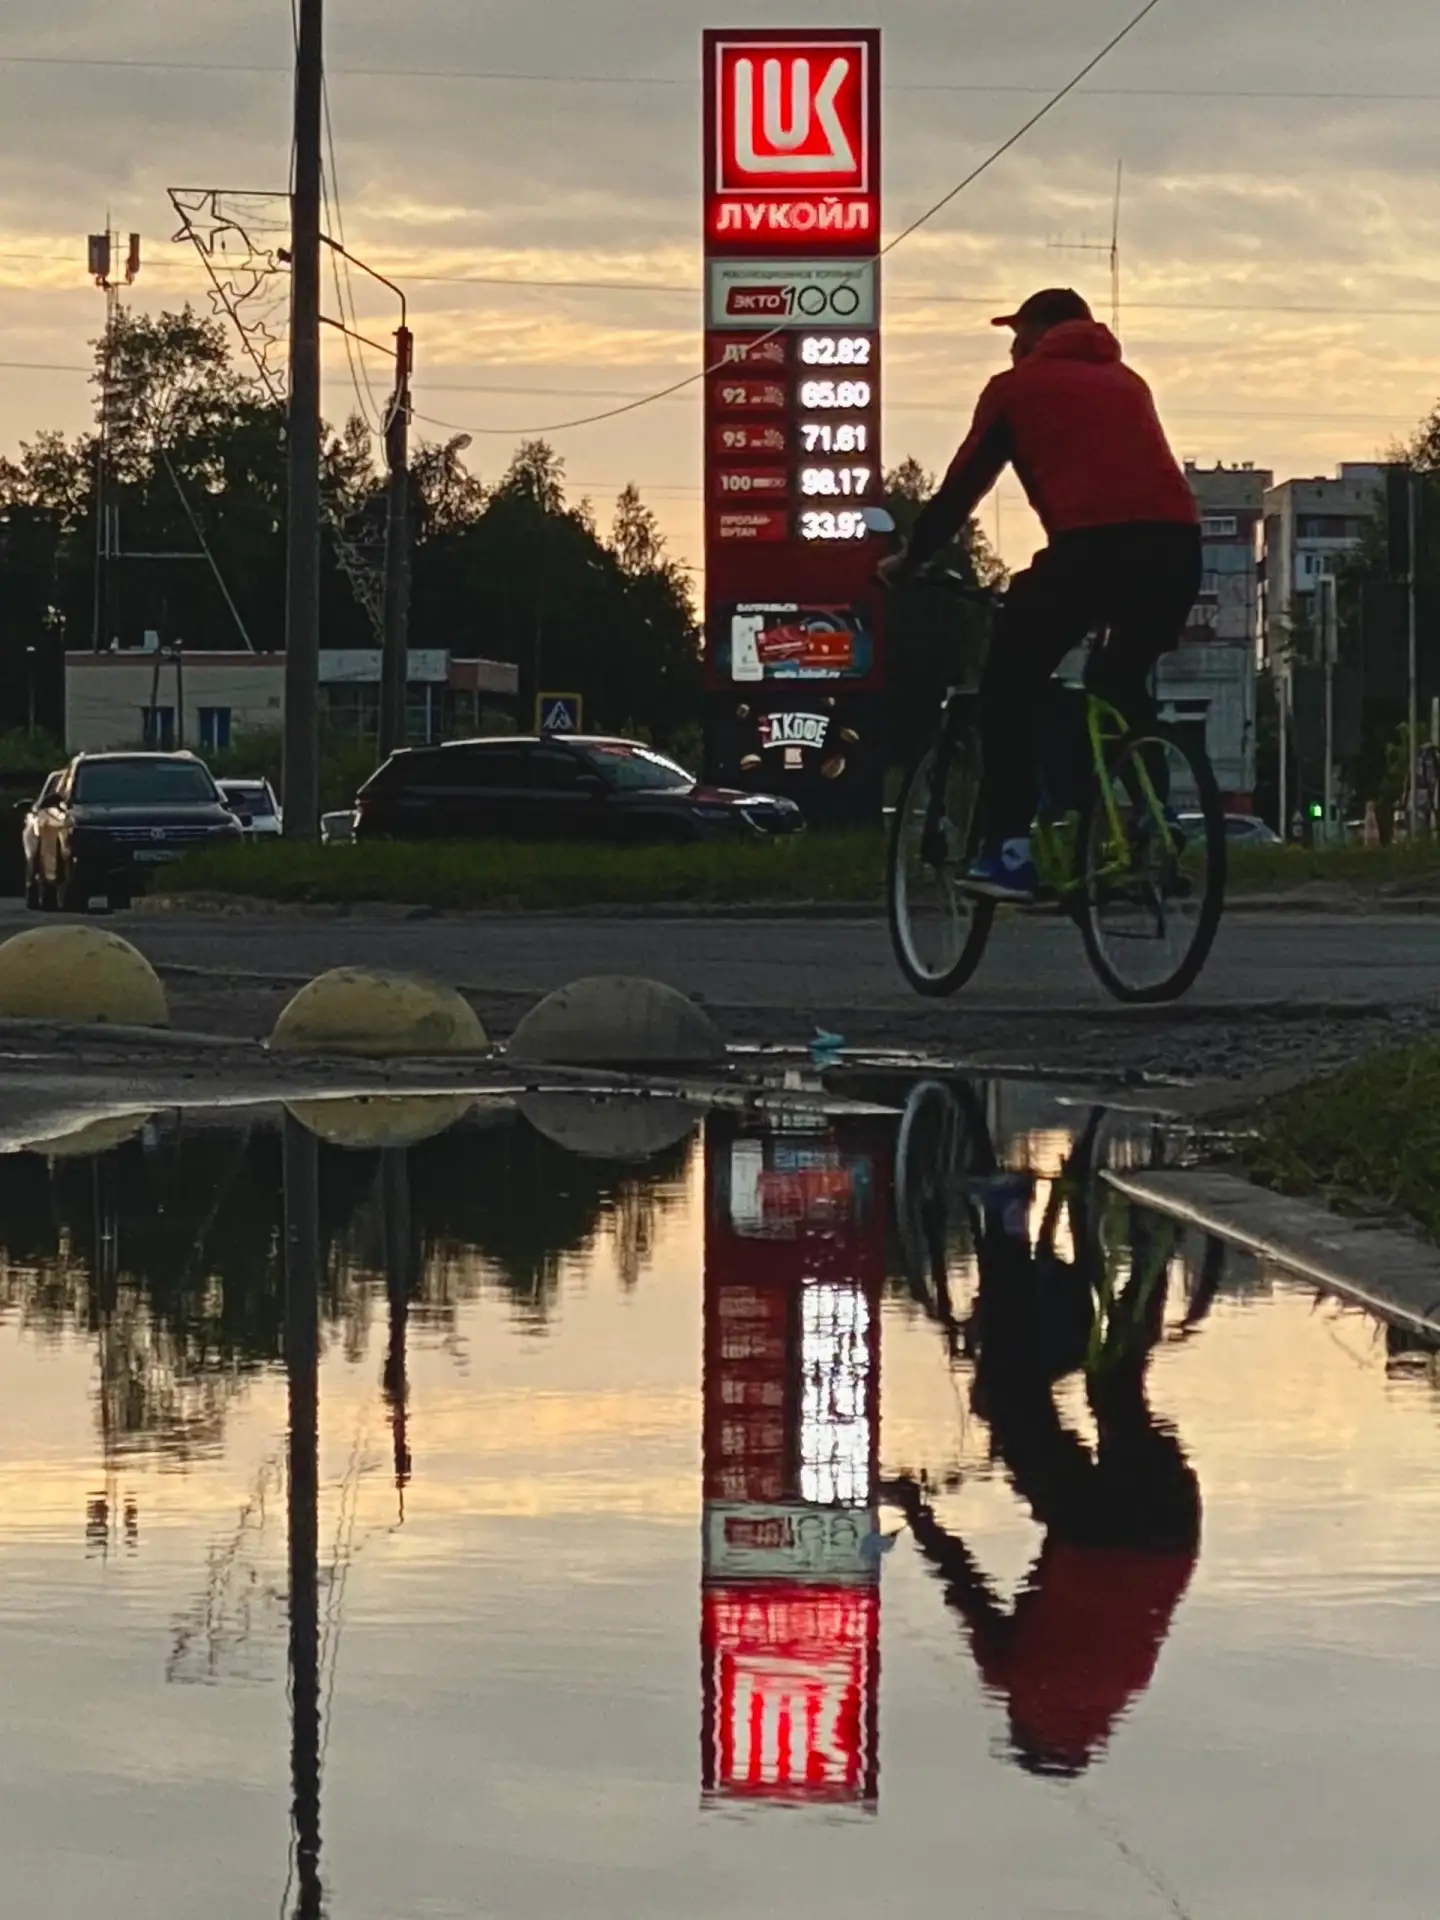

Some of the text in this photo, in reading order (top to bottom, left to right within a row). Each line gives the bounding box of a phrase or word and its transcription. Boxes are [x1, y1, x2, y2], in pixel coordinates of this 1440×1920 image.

[716, 196, 869, 230] ЛУКОЙЛ
[733, 284, 860, 316] ЭКТО 100
[723, 344, 748, 362] ДТ
[722, 387, 747, 404] 92
[722, 431, 747, 448] 95
[720, 475, 751, 491] 100
